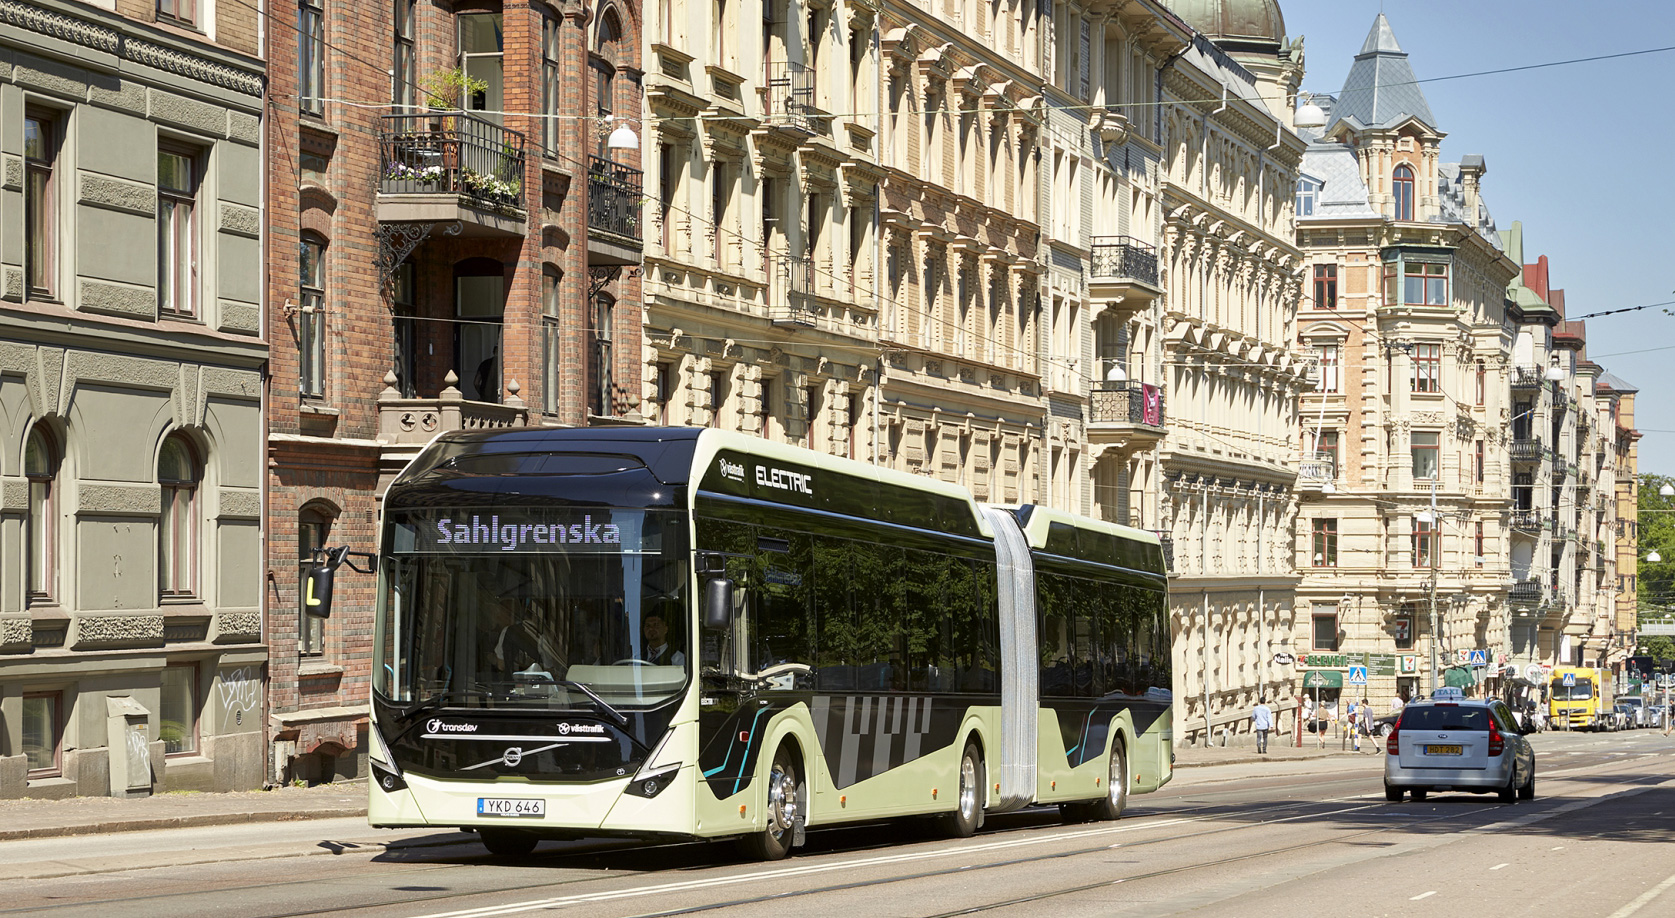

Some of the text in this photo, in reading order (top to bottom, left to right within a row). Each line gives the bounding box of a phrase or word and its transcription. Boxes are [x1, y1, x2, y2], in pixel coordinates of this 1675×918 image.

[755, 465, 813, 495] ELECTRIC
[437, 514, 621, 550] Sahlgrenska
[1274, 655, 1293, 664] Nails
[442, 722, 477, 732] transdev
[571, 724, 604, 734] västtrafik
[1430, 746, 1460, 754] HDT 282
[488, 800, 540, 813] YKD 646
